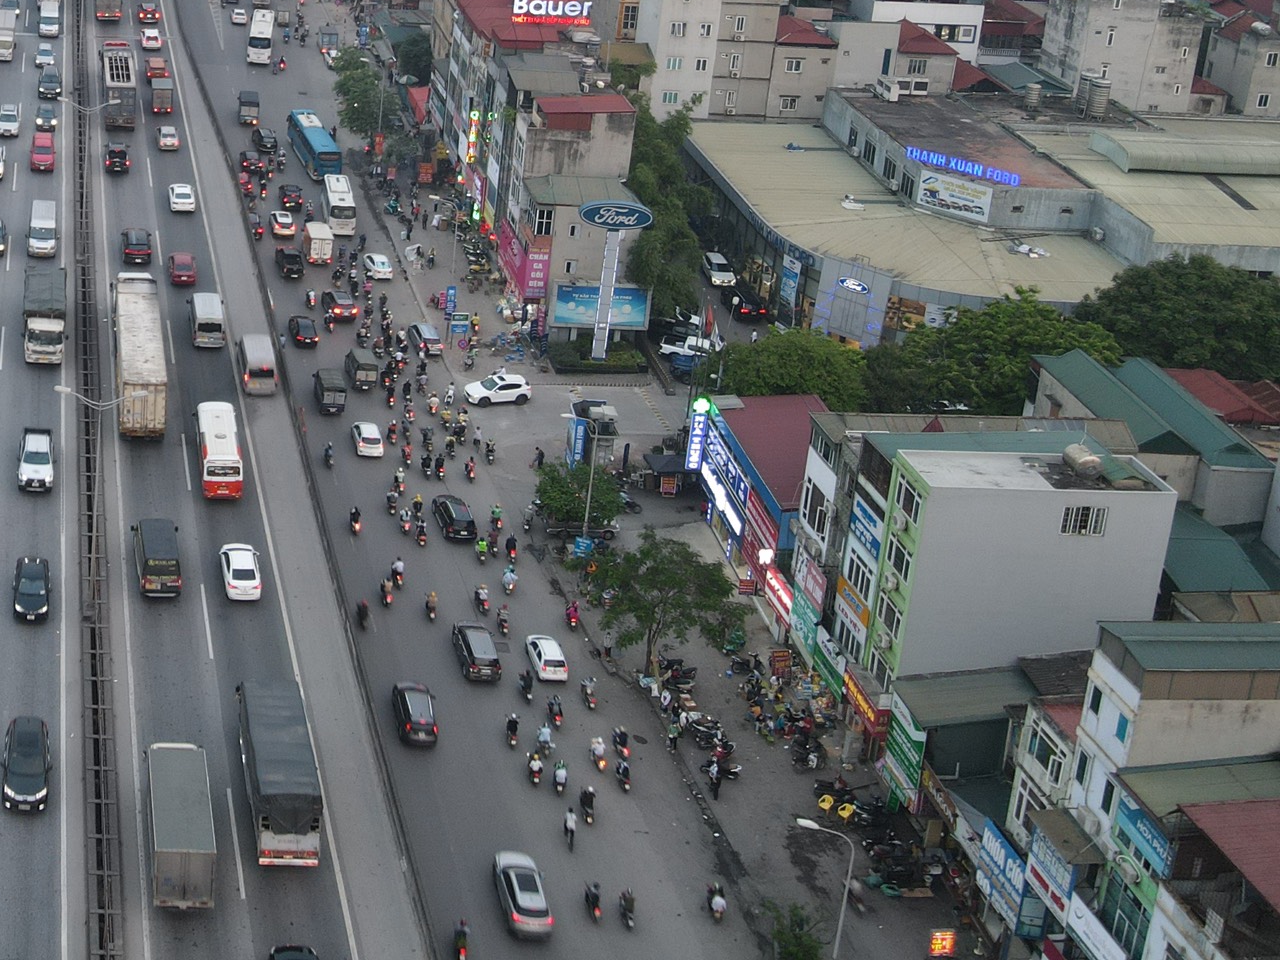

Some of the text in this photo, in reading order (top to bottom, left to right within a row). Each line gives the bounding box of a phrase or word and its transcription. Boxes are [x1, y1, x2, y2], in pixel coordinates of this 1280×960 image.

[906, 146, 1020, 187] THANH XUAN FORD
[594, 206, 639, 226] Ford
[787, 242, 816, 267] FORD
[981, 827, 1006, 871] KHÓA
